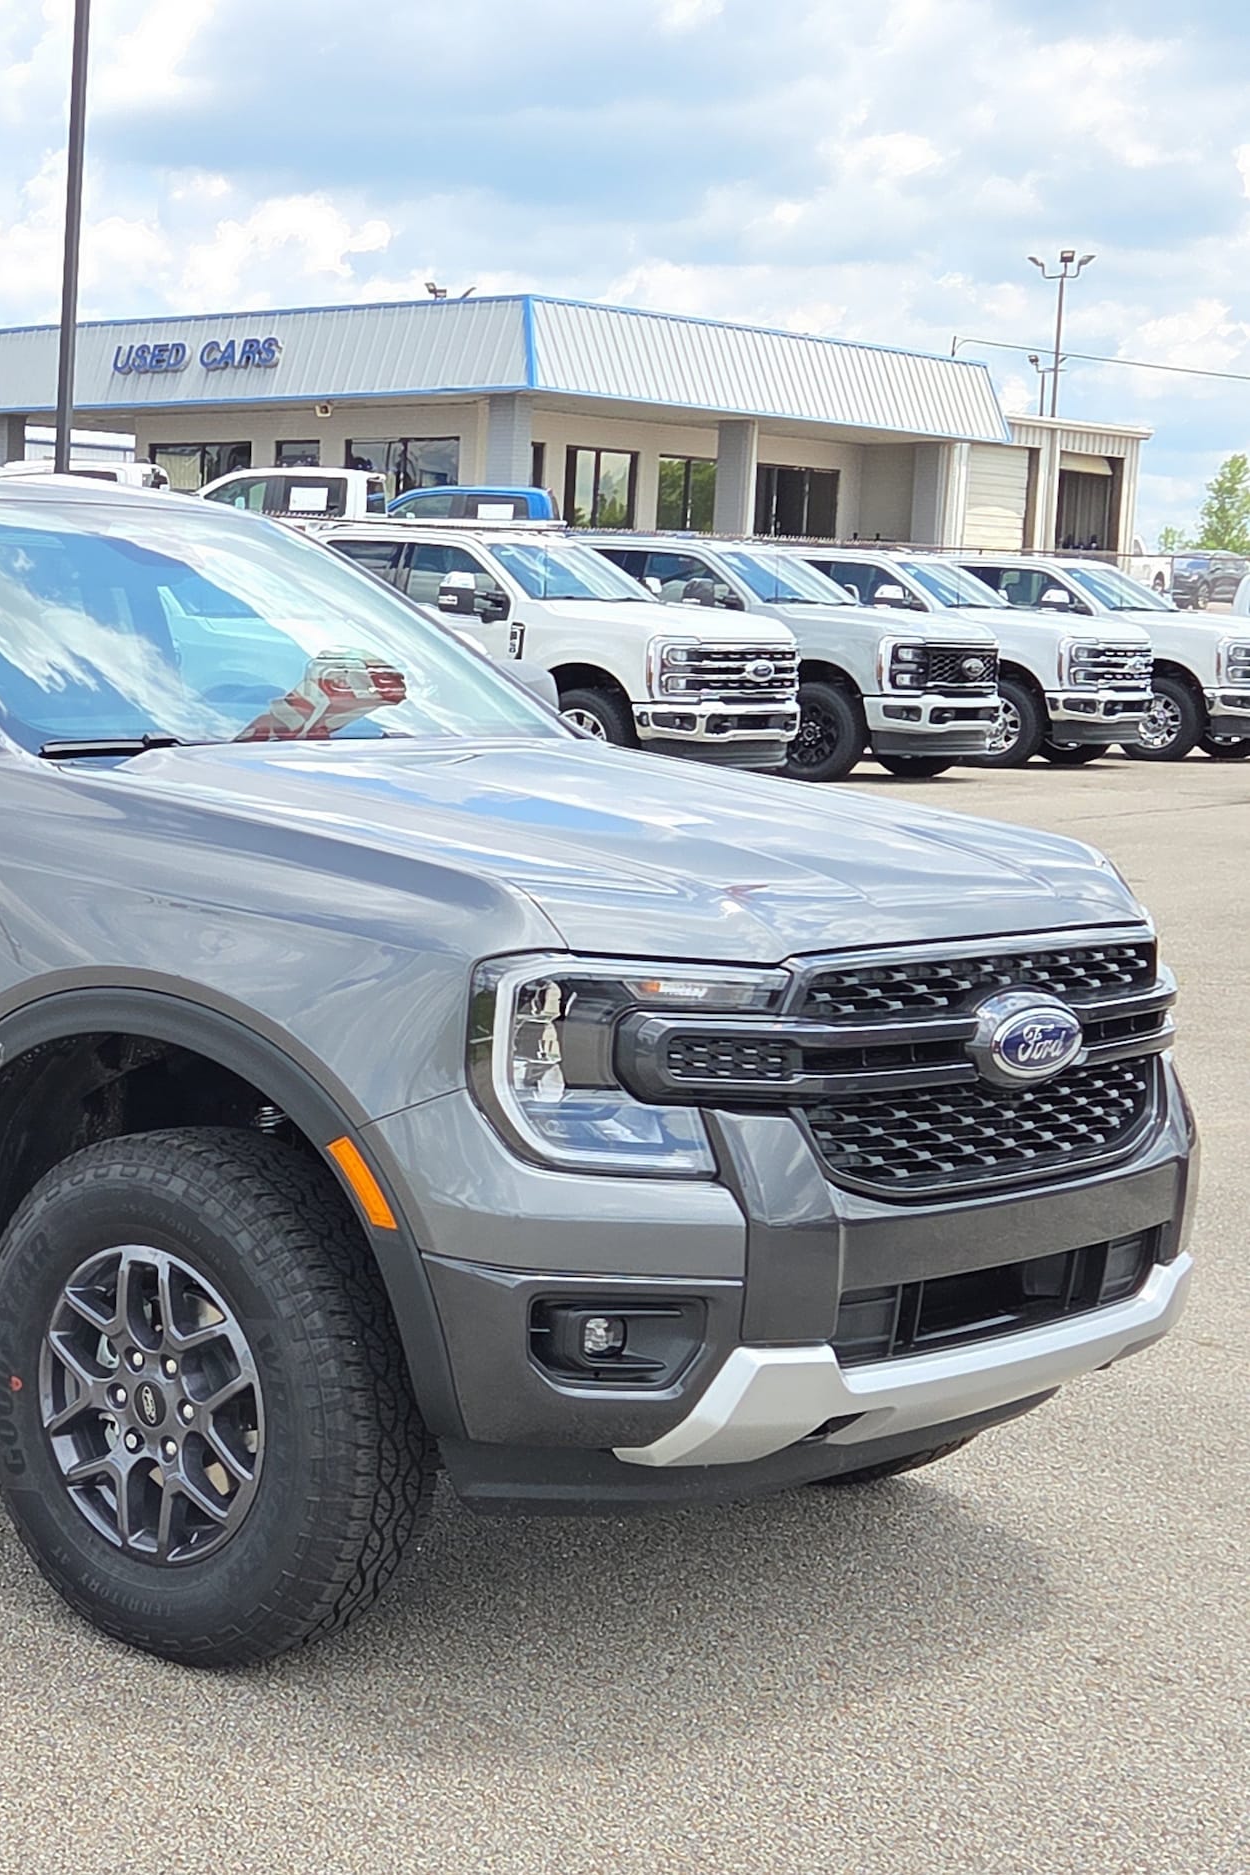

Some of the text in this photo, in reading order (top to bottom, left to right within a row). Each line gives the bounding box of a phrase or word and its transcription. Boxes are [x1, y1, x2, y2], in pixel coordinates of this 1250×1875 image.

[113, 337, 282, 374] USED CARS
[1017, 1024, 1066, 1062] Ford
[78, 1571, 173, 1618] TERRITORY
